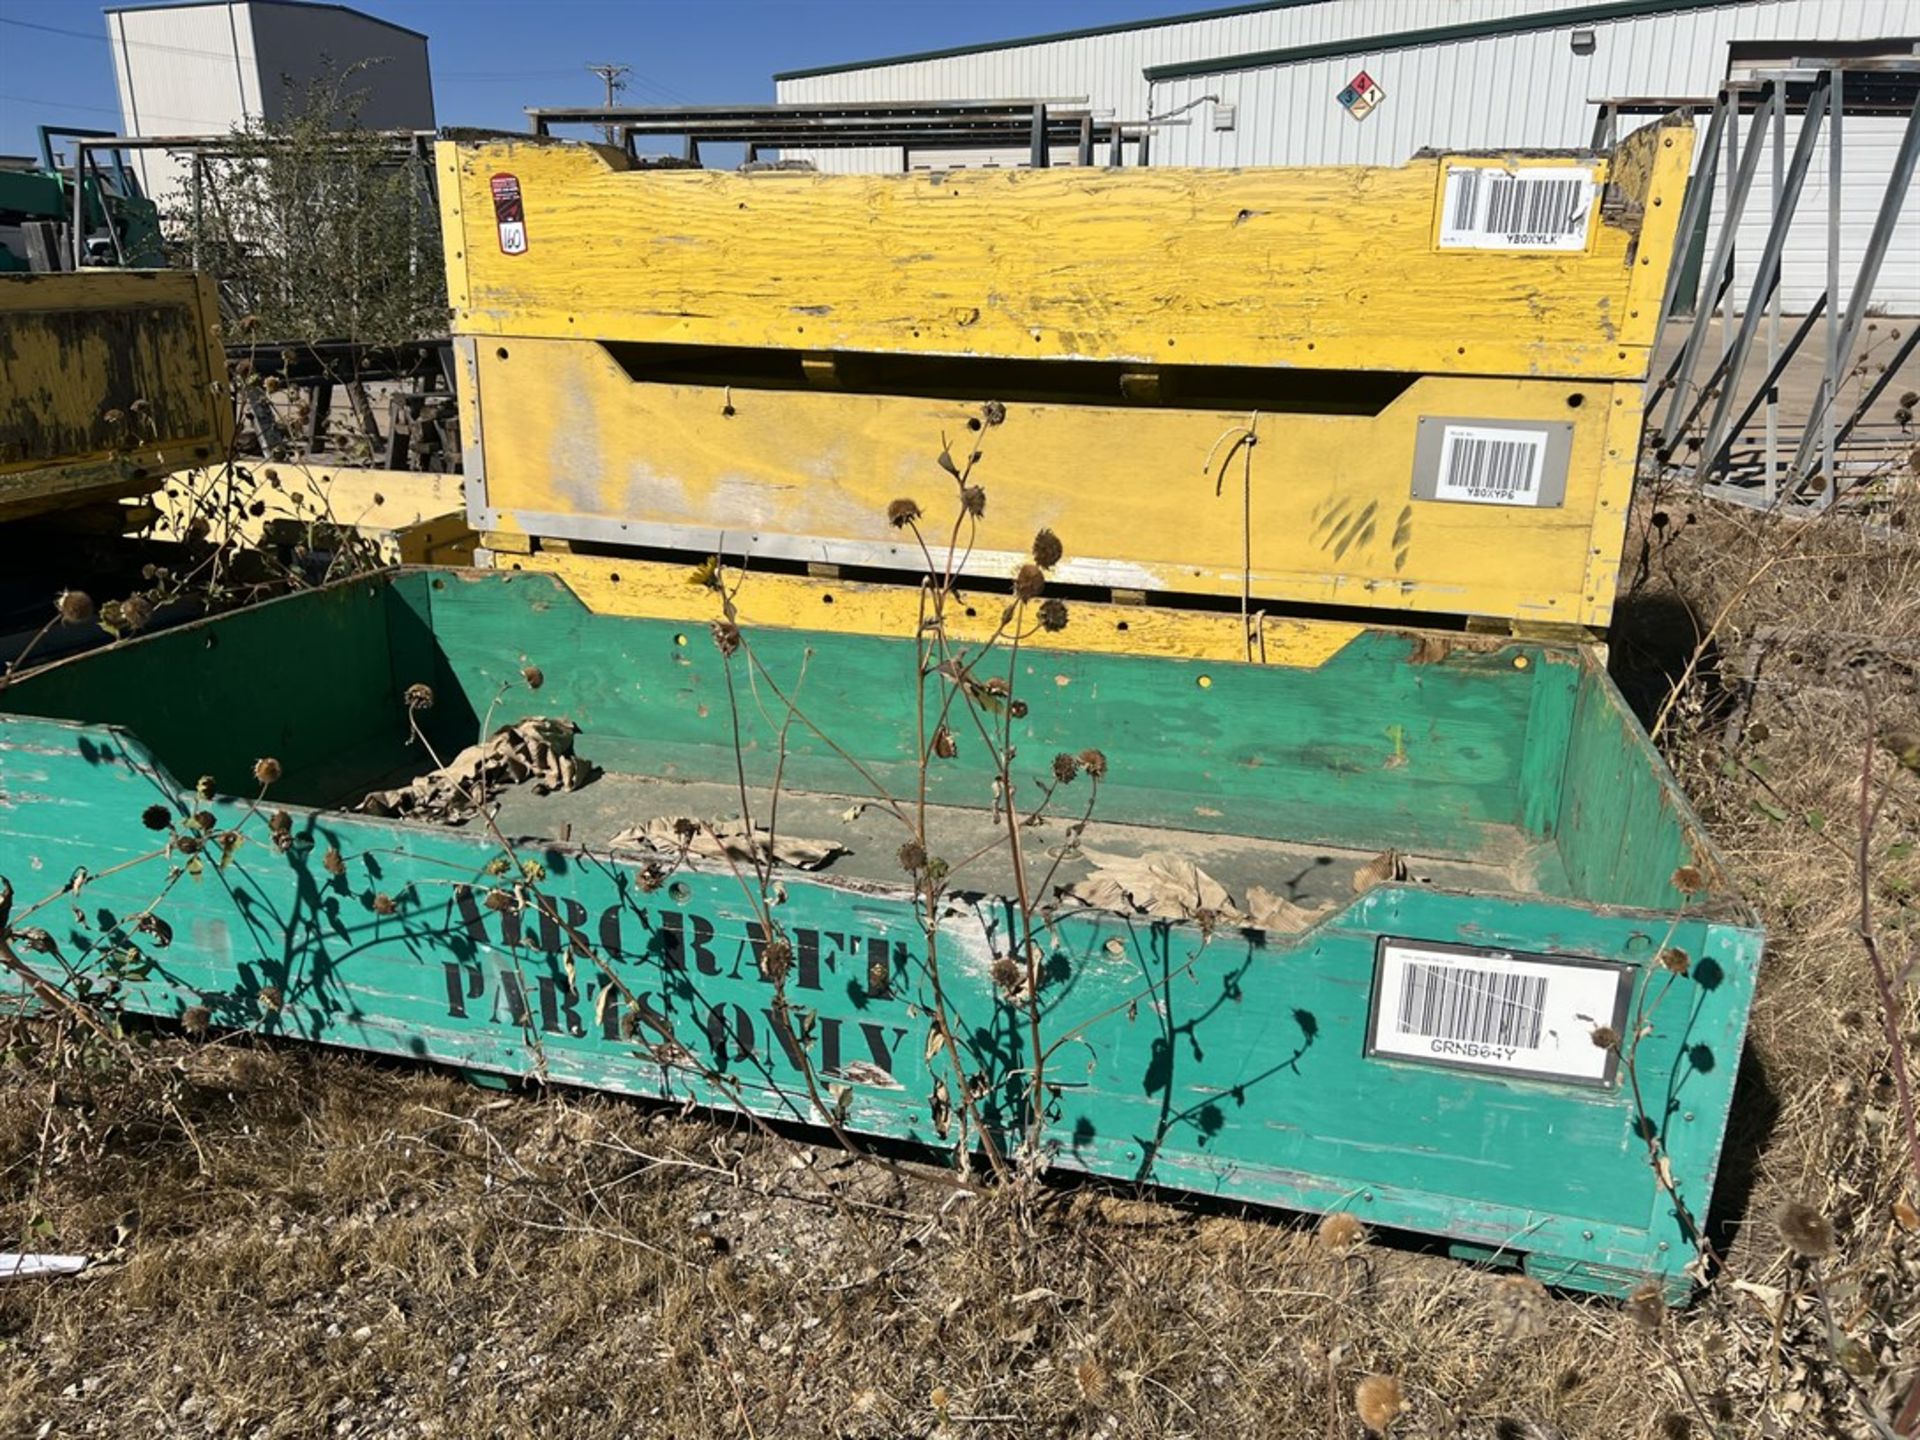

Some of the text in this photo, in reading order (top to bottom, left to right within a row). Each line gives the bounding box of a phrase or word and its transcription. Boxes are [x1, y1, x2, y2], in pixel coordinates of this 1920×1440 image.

[1357, 77, 1366, 90] 4
[1344, 89, 1375, 103] 3 1
[504, 227, 522, 249] 160
[447, 884, 908, 1002] AIRCRAFT
[442, 961, 908, 1077] PARTS ONLY
